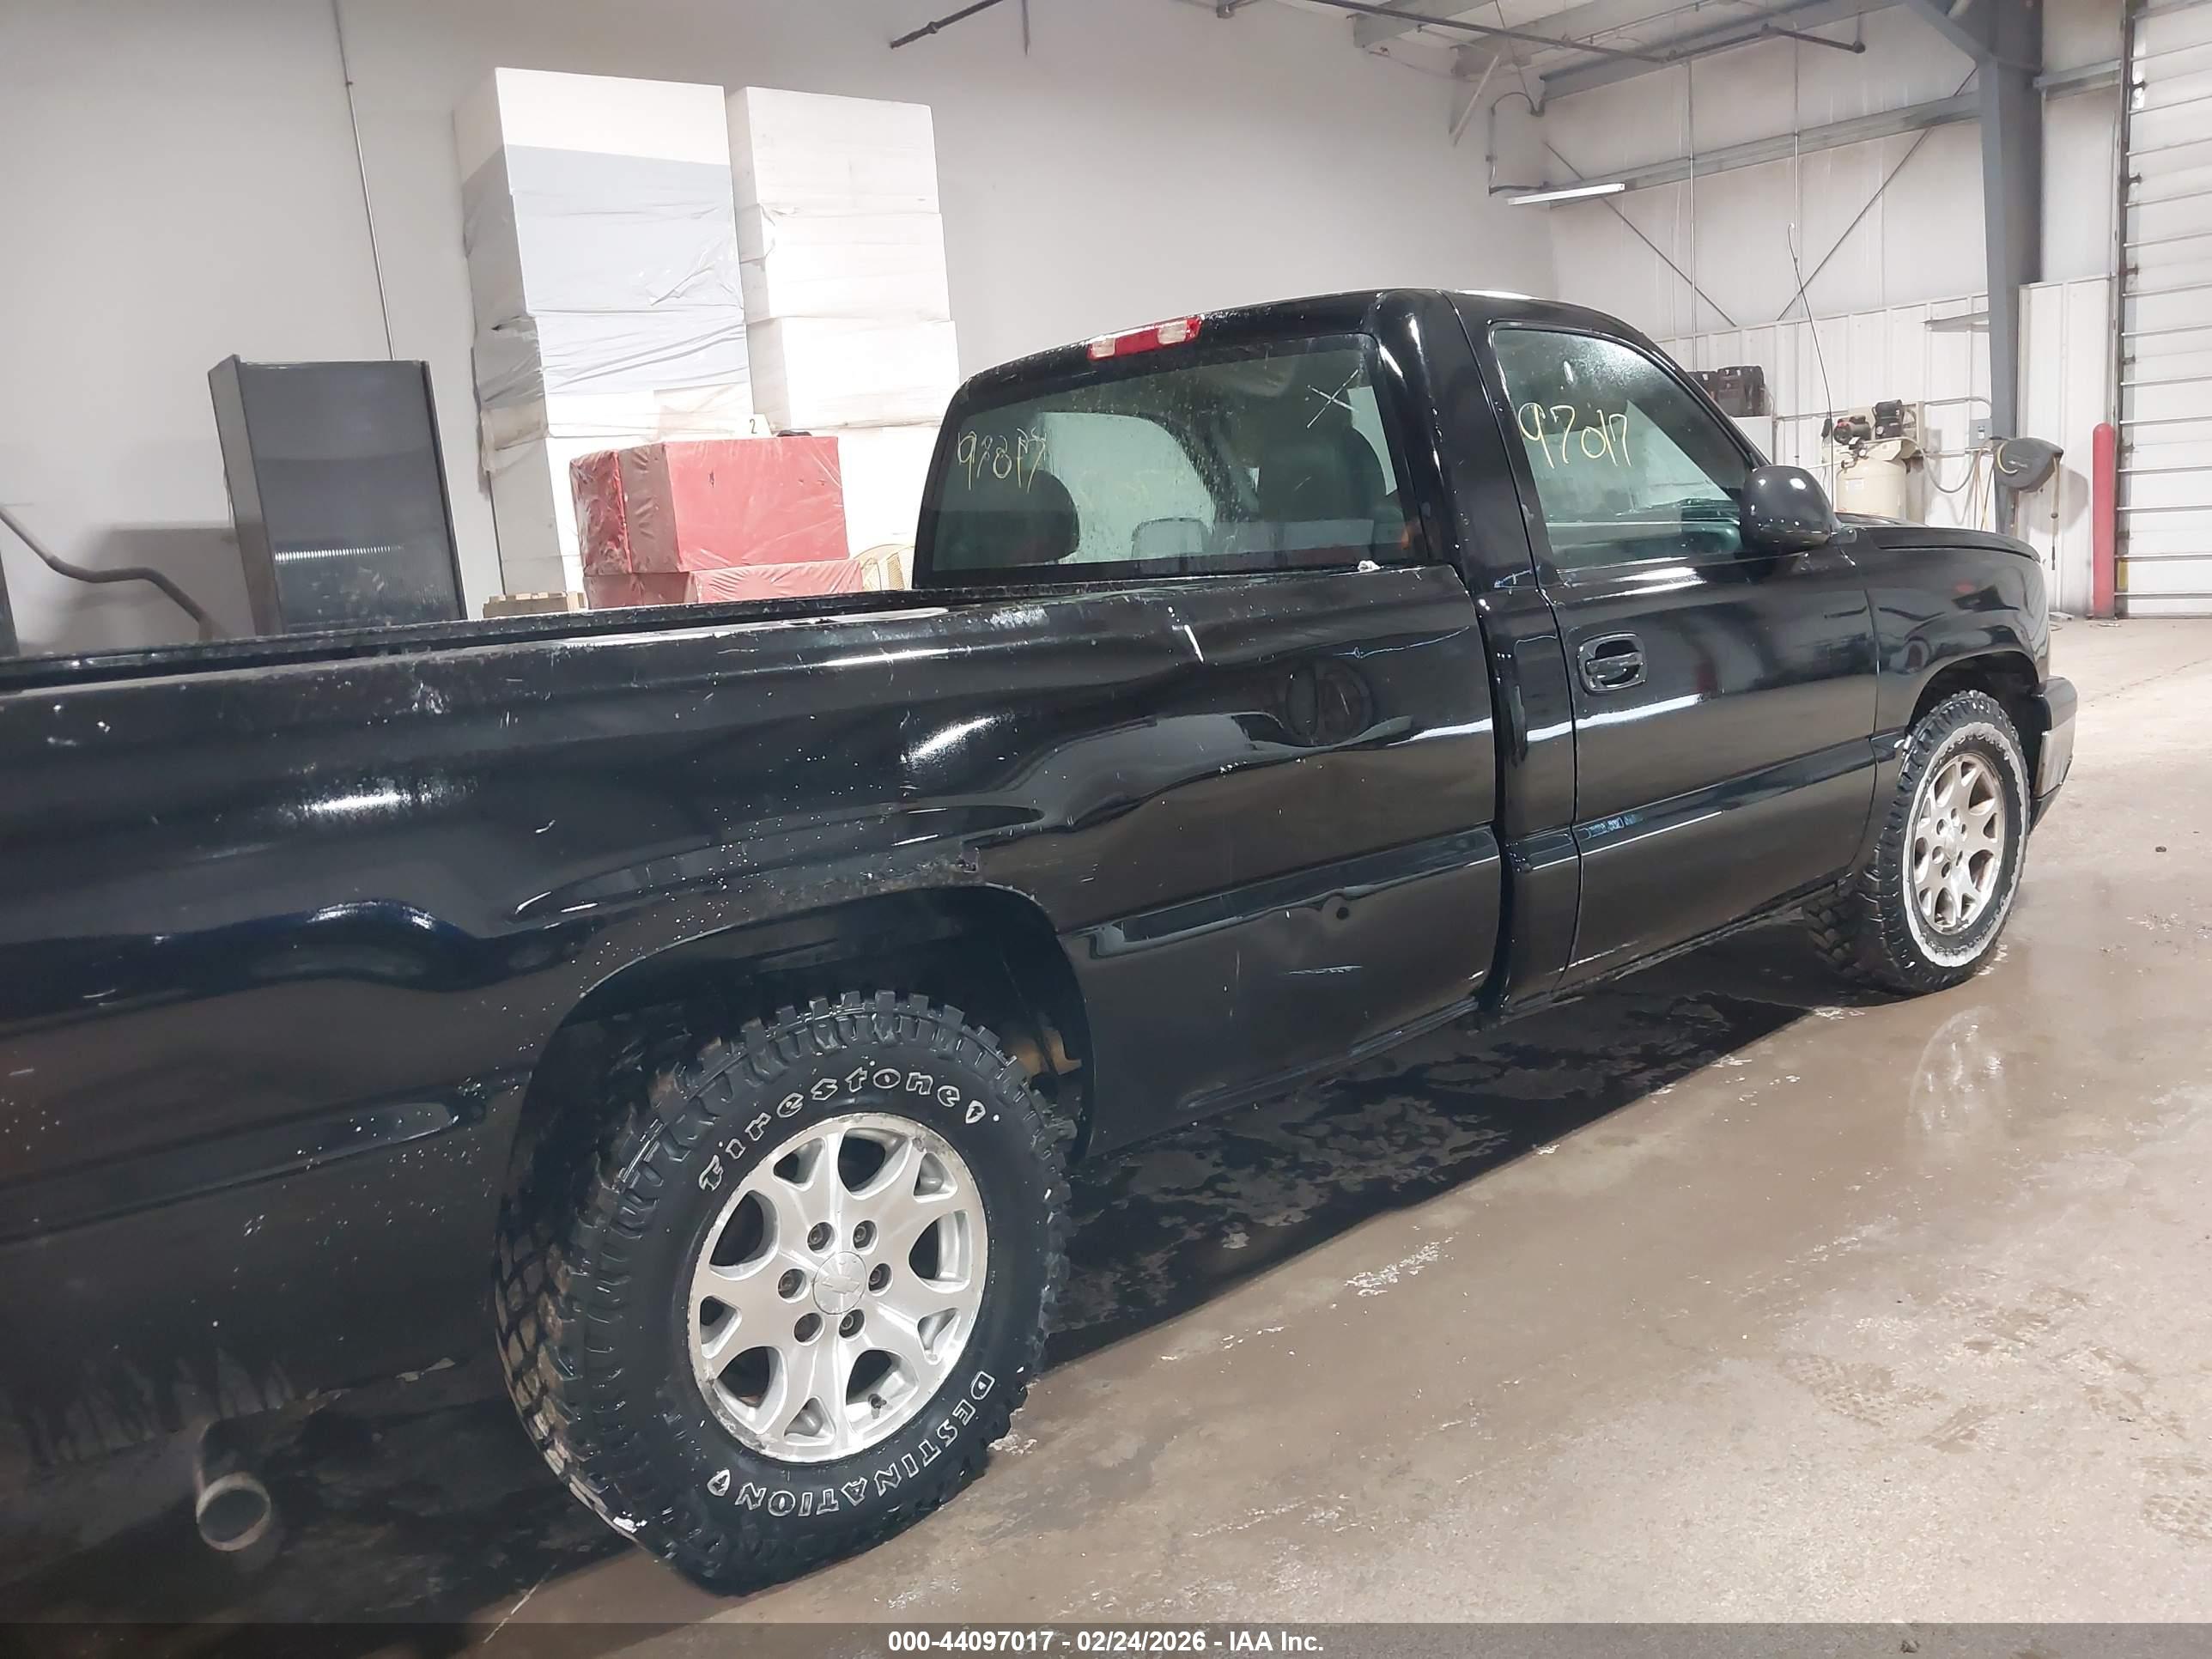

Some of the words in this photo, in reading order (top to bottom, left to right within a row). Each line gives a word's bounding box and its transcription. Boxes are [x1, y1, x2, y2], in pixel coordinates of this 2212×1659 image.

[749, 418, 757, 434] 2
[1517, 401, 1632, 470] 97017
[698, 1066, 961, 1192] Firestone
[734, 1370, 996, 1517] DESTINATION
